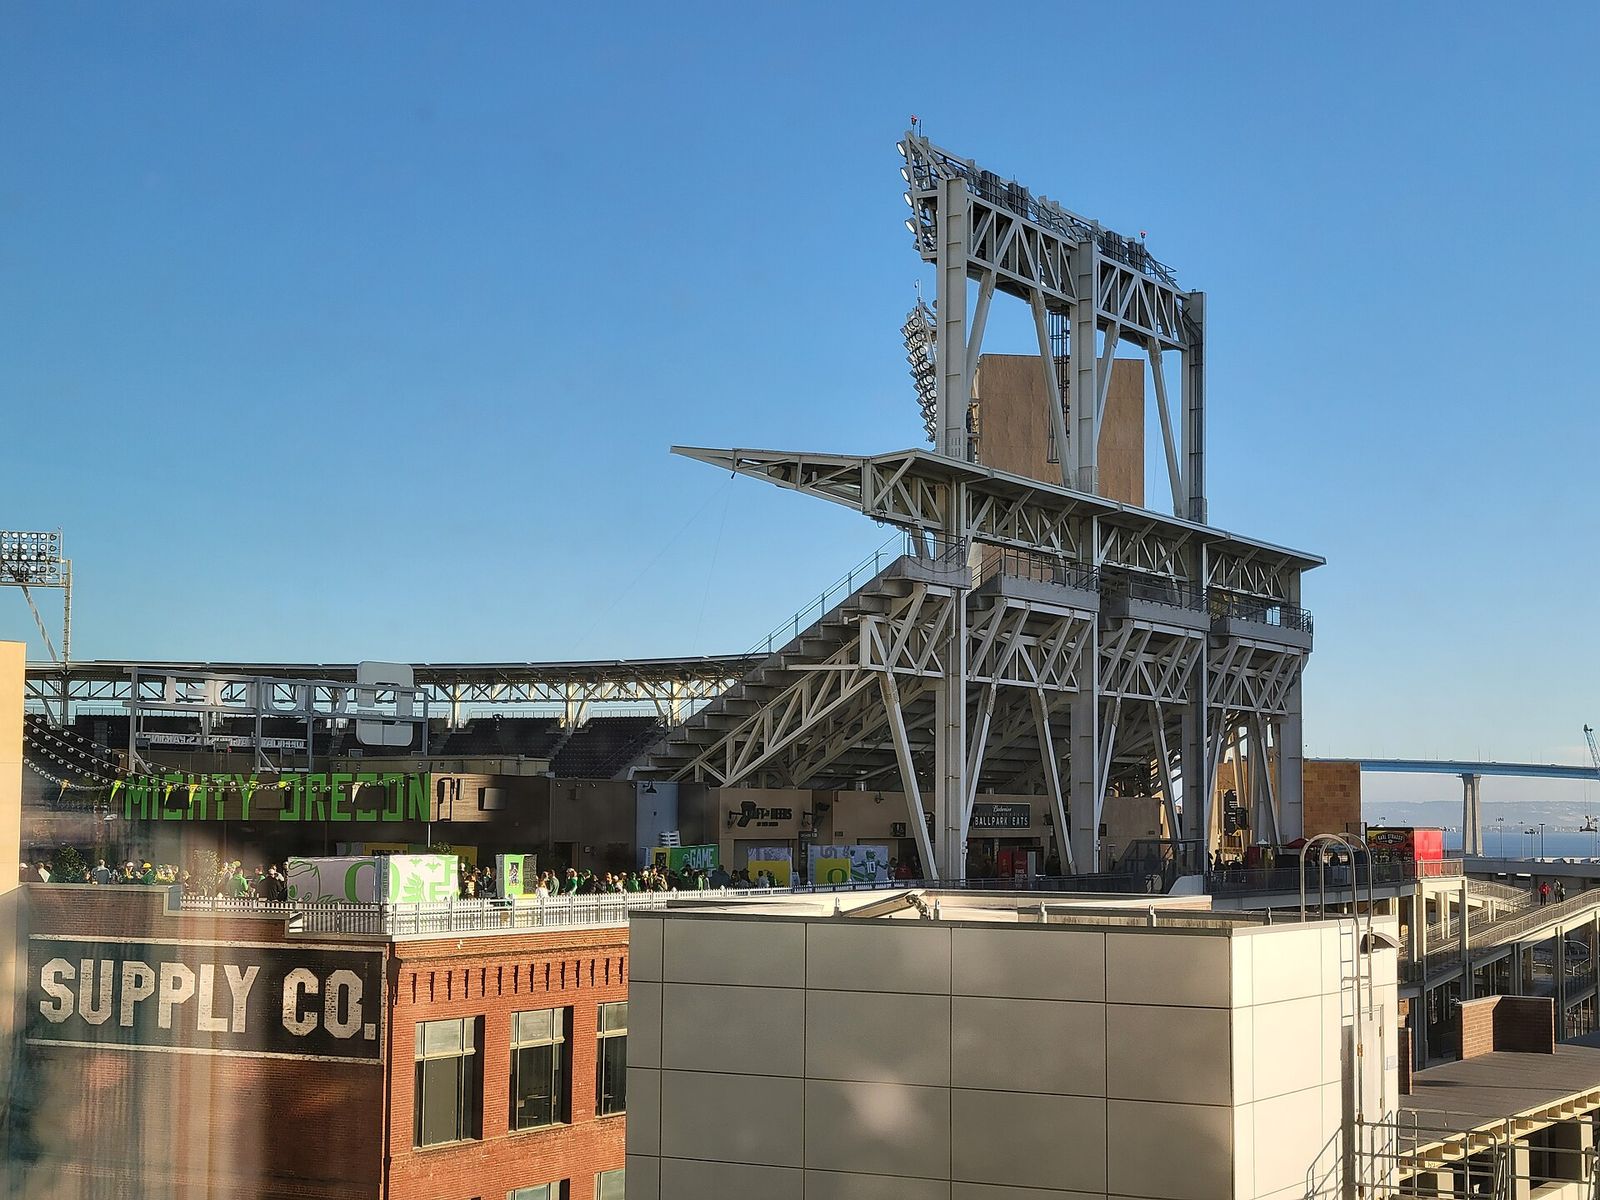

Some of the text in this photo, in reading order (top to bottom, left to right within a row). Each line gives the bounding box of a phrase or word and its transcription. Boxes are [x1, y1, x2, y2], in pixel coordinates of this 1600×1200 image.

[124, 772, 431, 822] MIGHTY OREGON
[974, 816, 1029, 826] BALLPARK EATS
[690, 847, 714, 868] GAME
[866, 861, 876, 872] 10
[39, 957, 376, 1041] SUPPLY CO.
